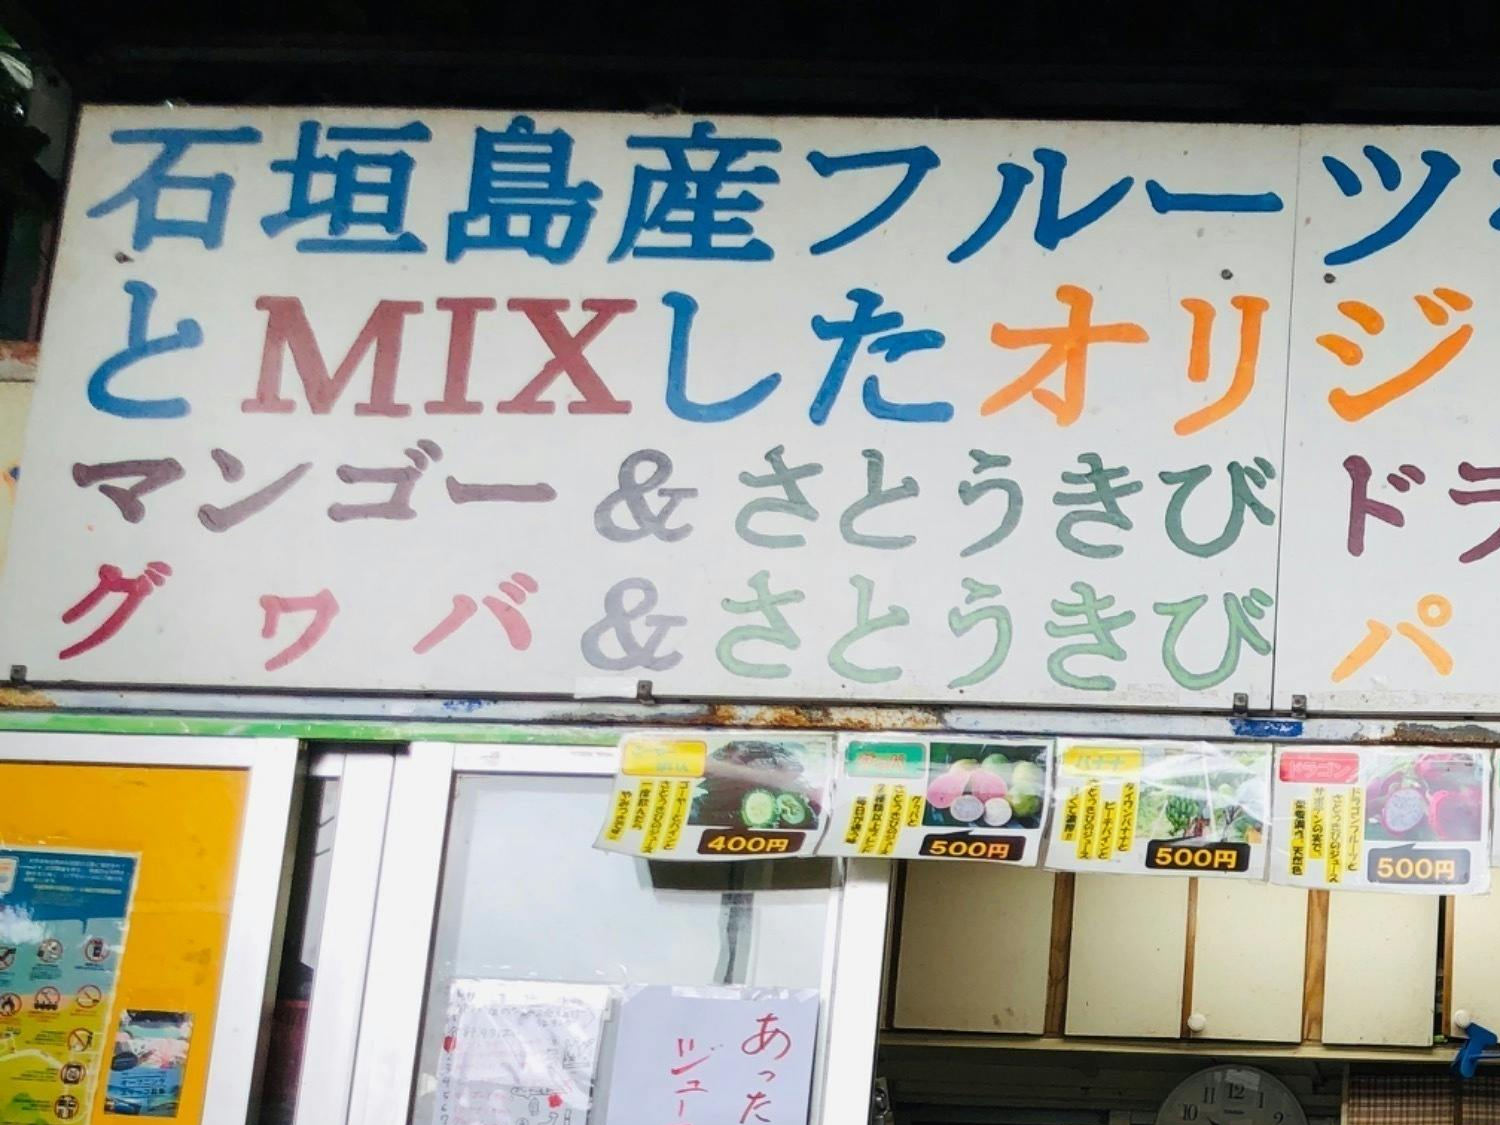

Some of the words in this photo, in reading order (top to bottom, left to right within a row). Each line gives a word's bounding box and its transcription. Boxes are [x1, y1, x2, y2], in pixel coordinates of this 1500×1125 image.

[708, 835, 788, 852] 400円
[929, 841, 1009, 858] 500円
[1155, 848, 1237, 868] 500円
[1377, 858, 1455, 879] 500円
[1204, 1086, 1215, 1104] 11
[1227, 1083, 1245, 1099] 12
[1183, 1104, 1198, 1121] 10
